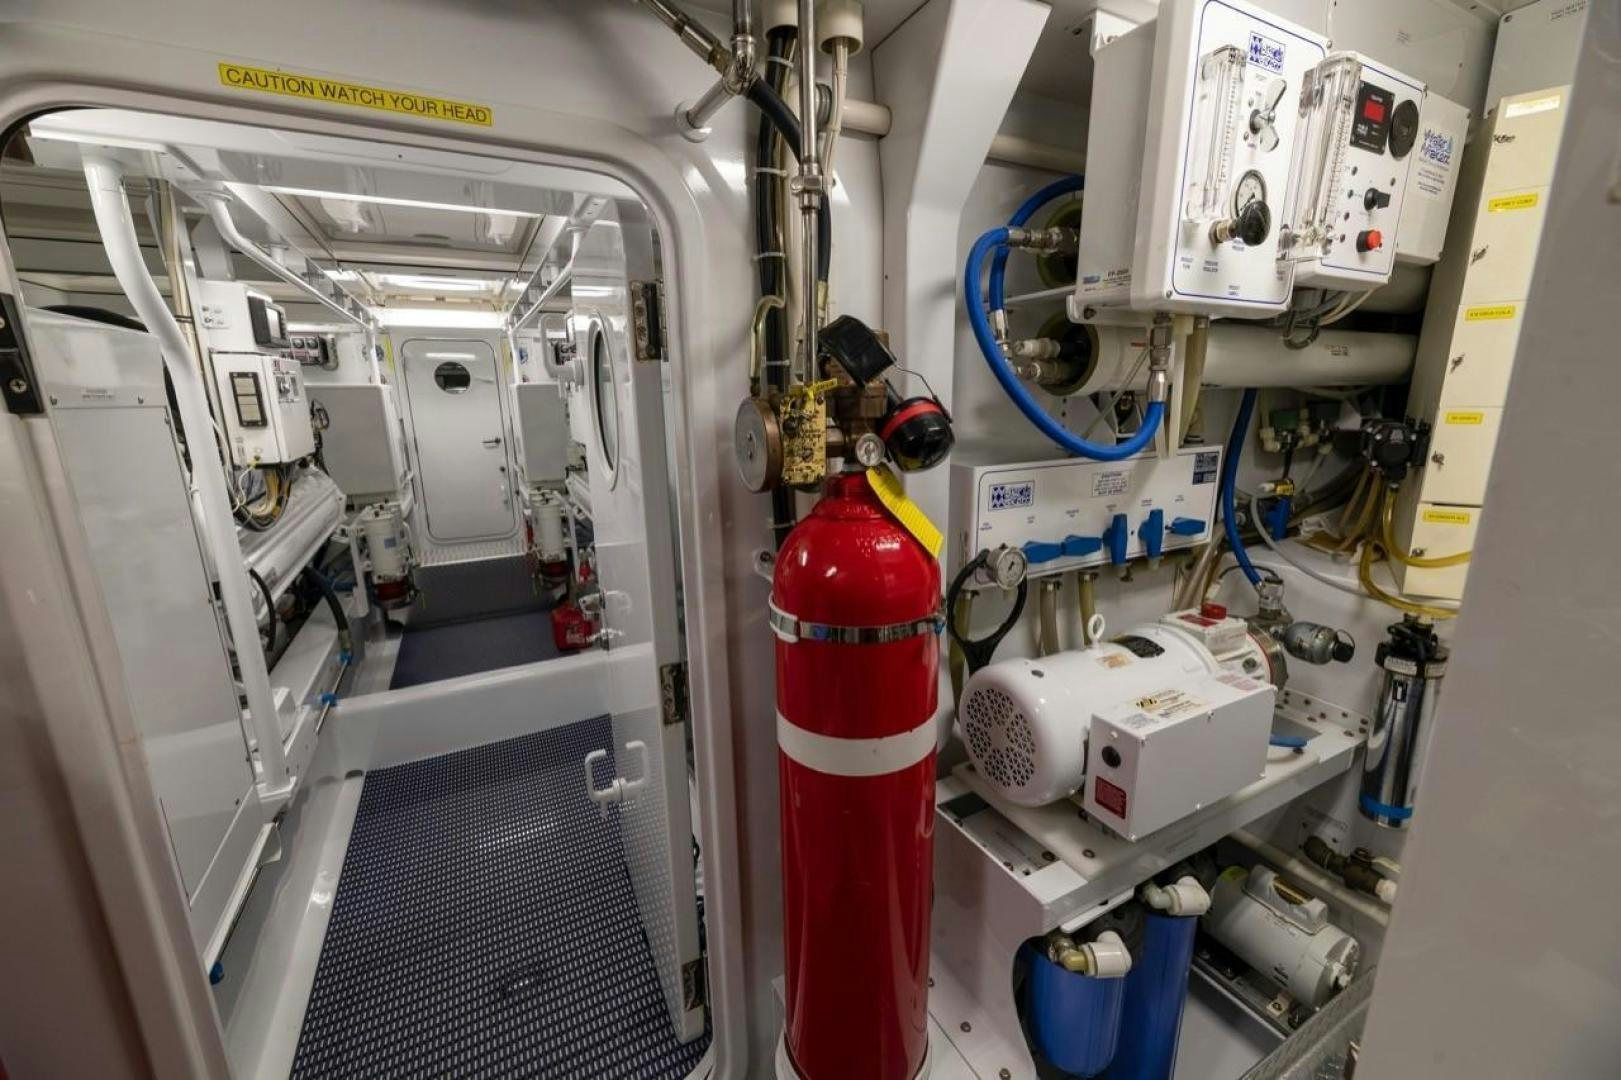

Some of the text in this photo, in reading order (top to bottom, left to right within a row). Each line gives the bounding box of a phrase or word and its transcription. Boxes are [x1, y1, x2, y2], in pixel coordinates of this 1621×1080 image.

[226, 68, 488, 122] CAUTION WATCH YOUR HEAD
